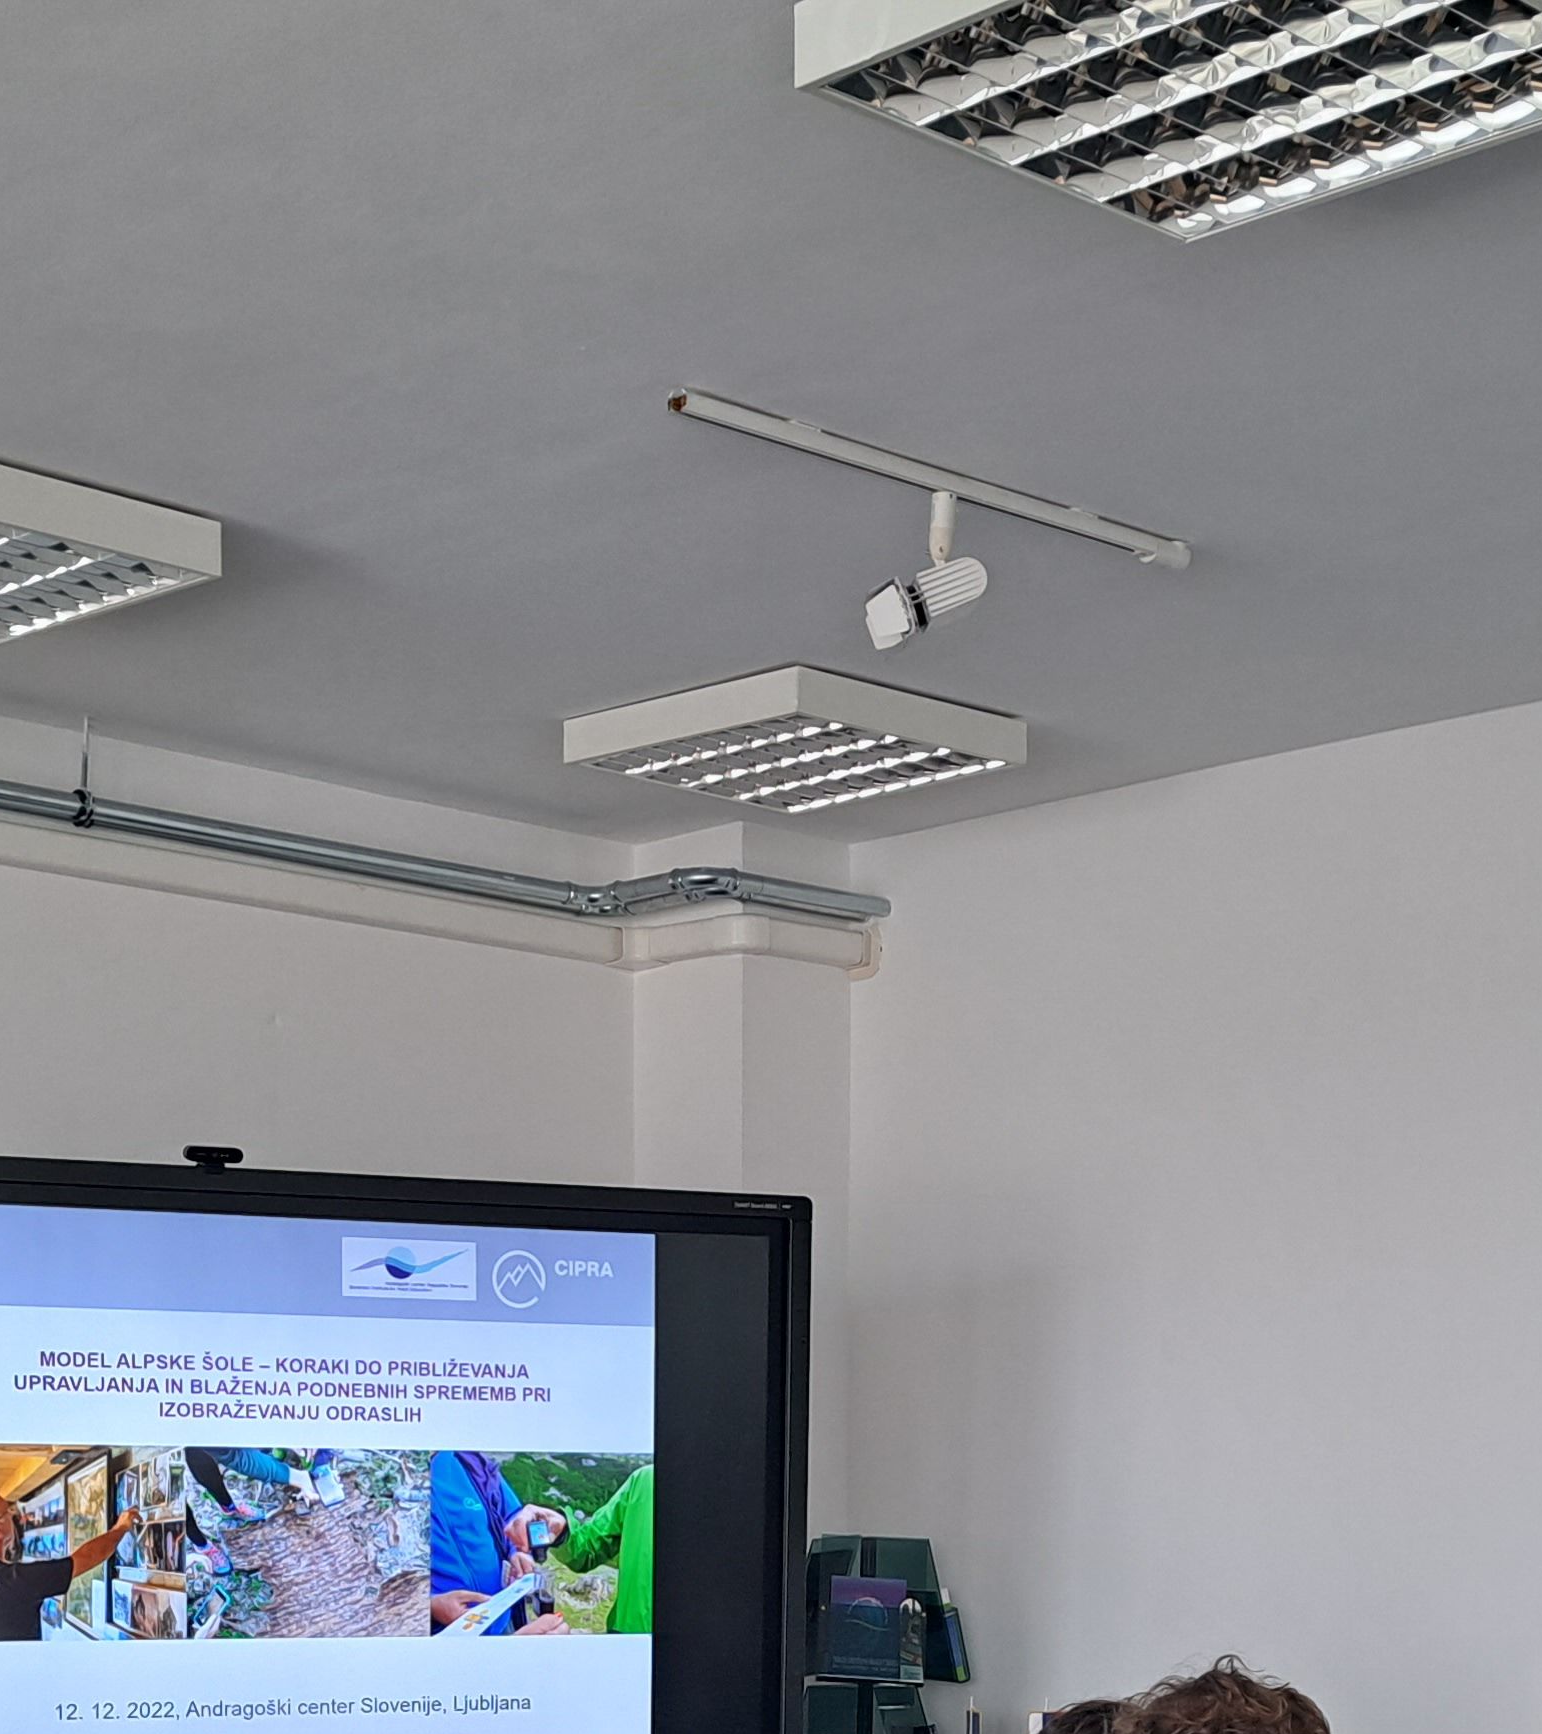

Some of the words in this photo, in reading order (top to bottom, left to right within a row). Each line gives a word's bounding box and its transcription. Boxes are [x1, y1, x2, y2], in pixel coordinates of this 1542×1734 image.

[554, 1259, 614, 1279] CIPRA
[39, 1350, 112, 1370] MODEL
[116, 1352, 196, 1371] ALPSKE
[202, 1350, 254, 1373] ŠOLE
[275, 1357, 350, 1375] KORAKI
[355, 1359, 382, 1376] DO
[387, 1358, 530, 1380] PRIBLIŽEVANJA
[13, 1374, 160, 1394] UPRAVLJANJA
[165, 1377, 184, 1395] IN
[190, 1375, 292, 1397] BLAŽENJA
[297, 1381, 408, 1400] PODNEBNIH
[413, 1384, 517, 1402] SPREMEMB
[522, 1386, 552, 1403] PRI
[158, 1399, 320, 1420] IZOBRAŽEVANJU
[325, 1405, 422, 1423] ODRASLIH
[55, 1703, 84, 1721] 12.
[91, 1702, 120, 1720] 12.
[126, 1701, 181, 1721] 2022,
[185, 1698, 292, 1721] Andragoški
[297, 1699, 356, 1715] center
[360, 1695, 447, 1717] Slovenije,
[453, 1694, 532, 1715] Ljubljana
